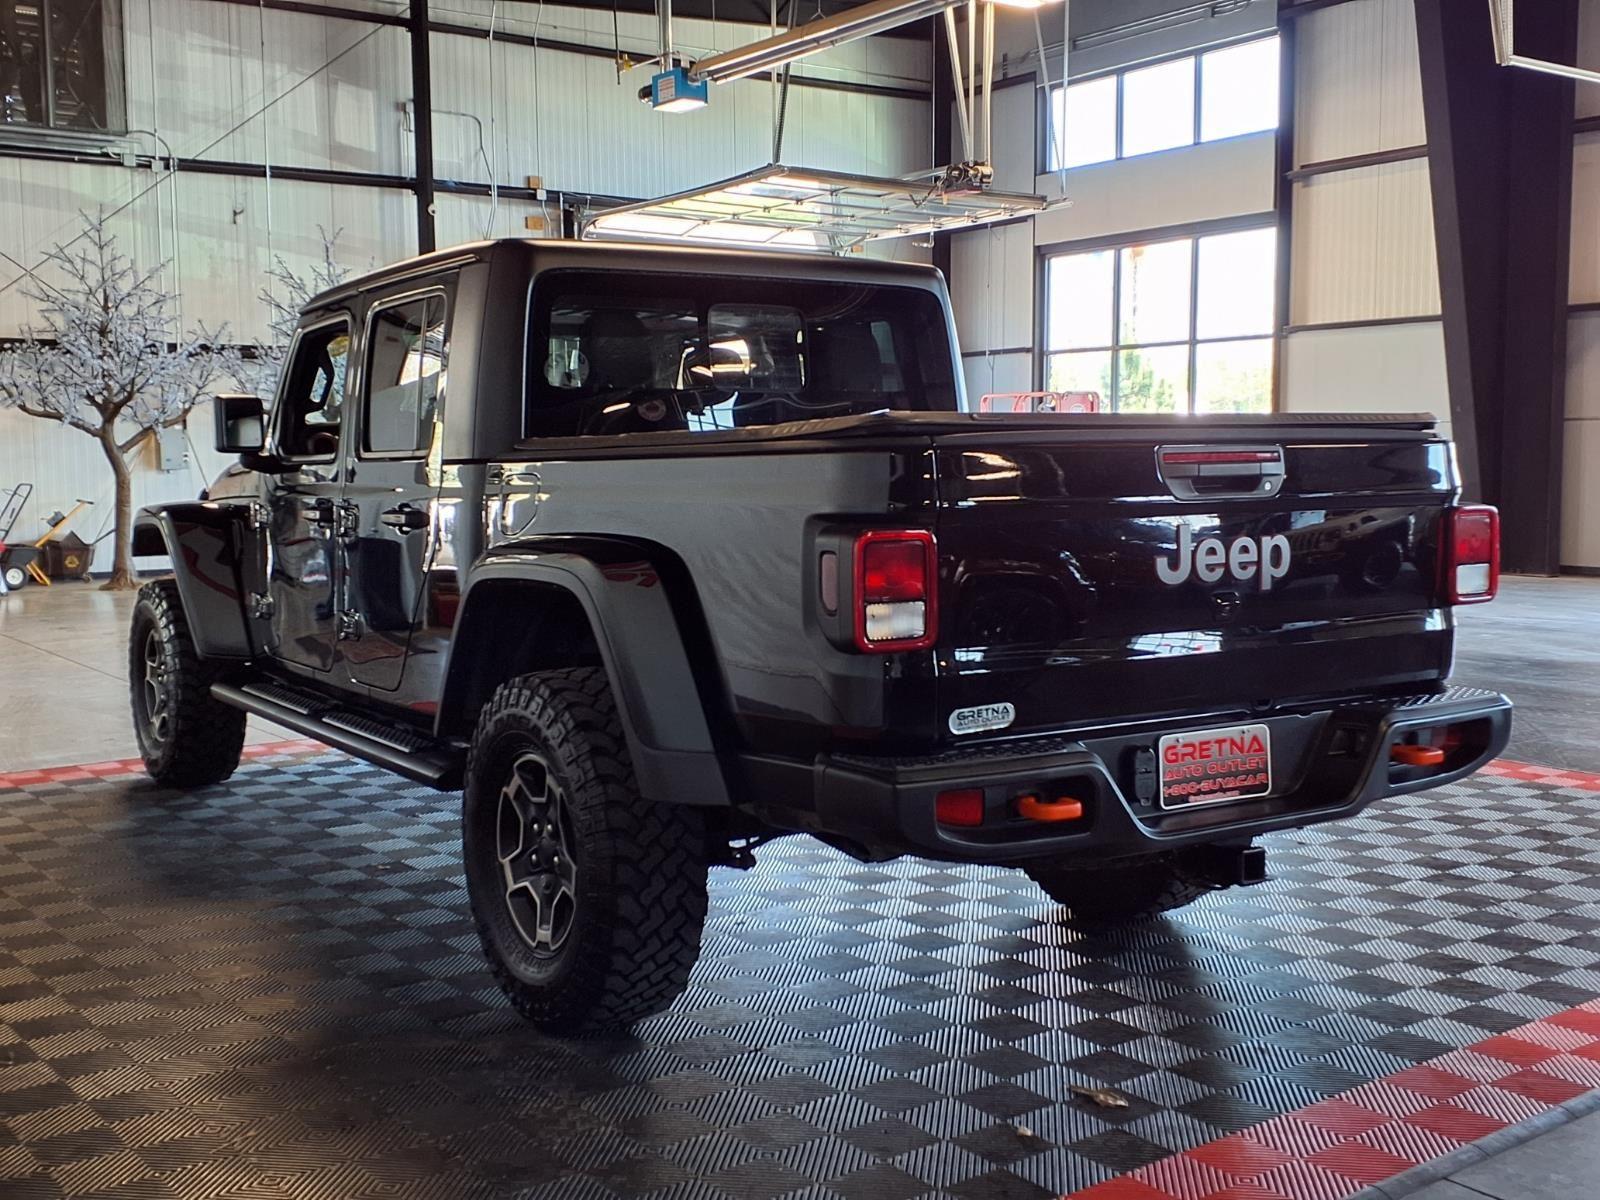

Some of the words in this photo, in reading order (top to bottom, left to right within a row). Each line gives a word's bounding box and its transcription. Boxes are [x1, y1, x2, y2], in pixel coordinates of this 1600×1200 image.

[1155, 524, 1291, 590] Jeep
[956, 705, 1010, 721] GRETNA
[958, 718, 980, 727] AUTO
[981, 714, 1010, 723] OUTLET
[1163, 735, 1265, 764] GRETNA
[1164, 764, 1203, 780] AUTO
[1207, 757, 1266, 774] OUTLET
